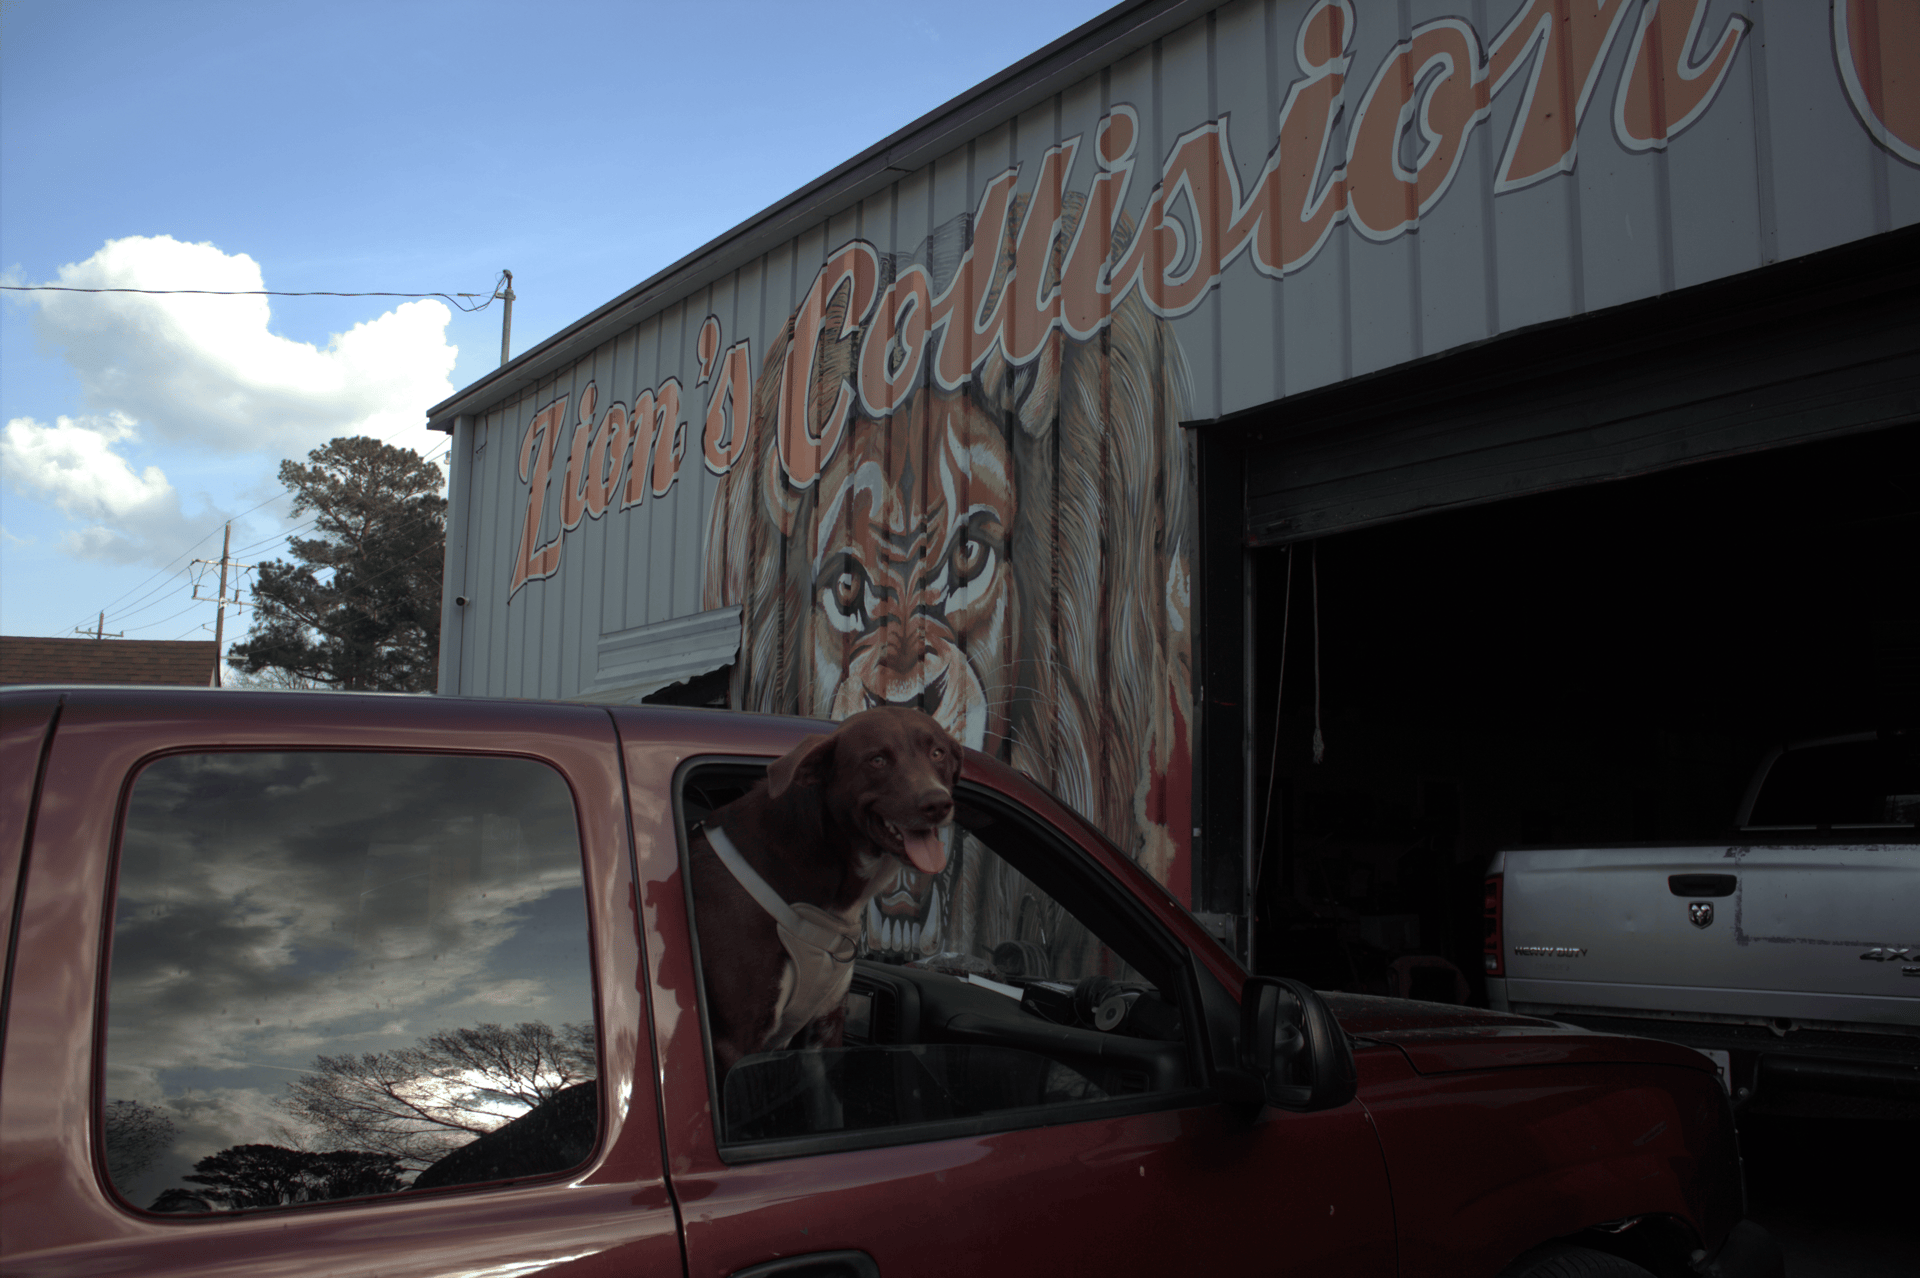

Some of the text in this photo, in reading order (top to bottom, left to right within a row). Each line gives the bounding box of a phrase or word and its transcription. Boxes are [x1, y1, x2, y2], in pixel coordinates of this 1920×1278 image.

[777, 0, 1754, 491] Collision
[1514, 945, 1588, 958] HEAVY DUTY
